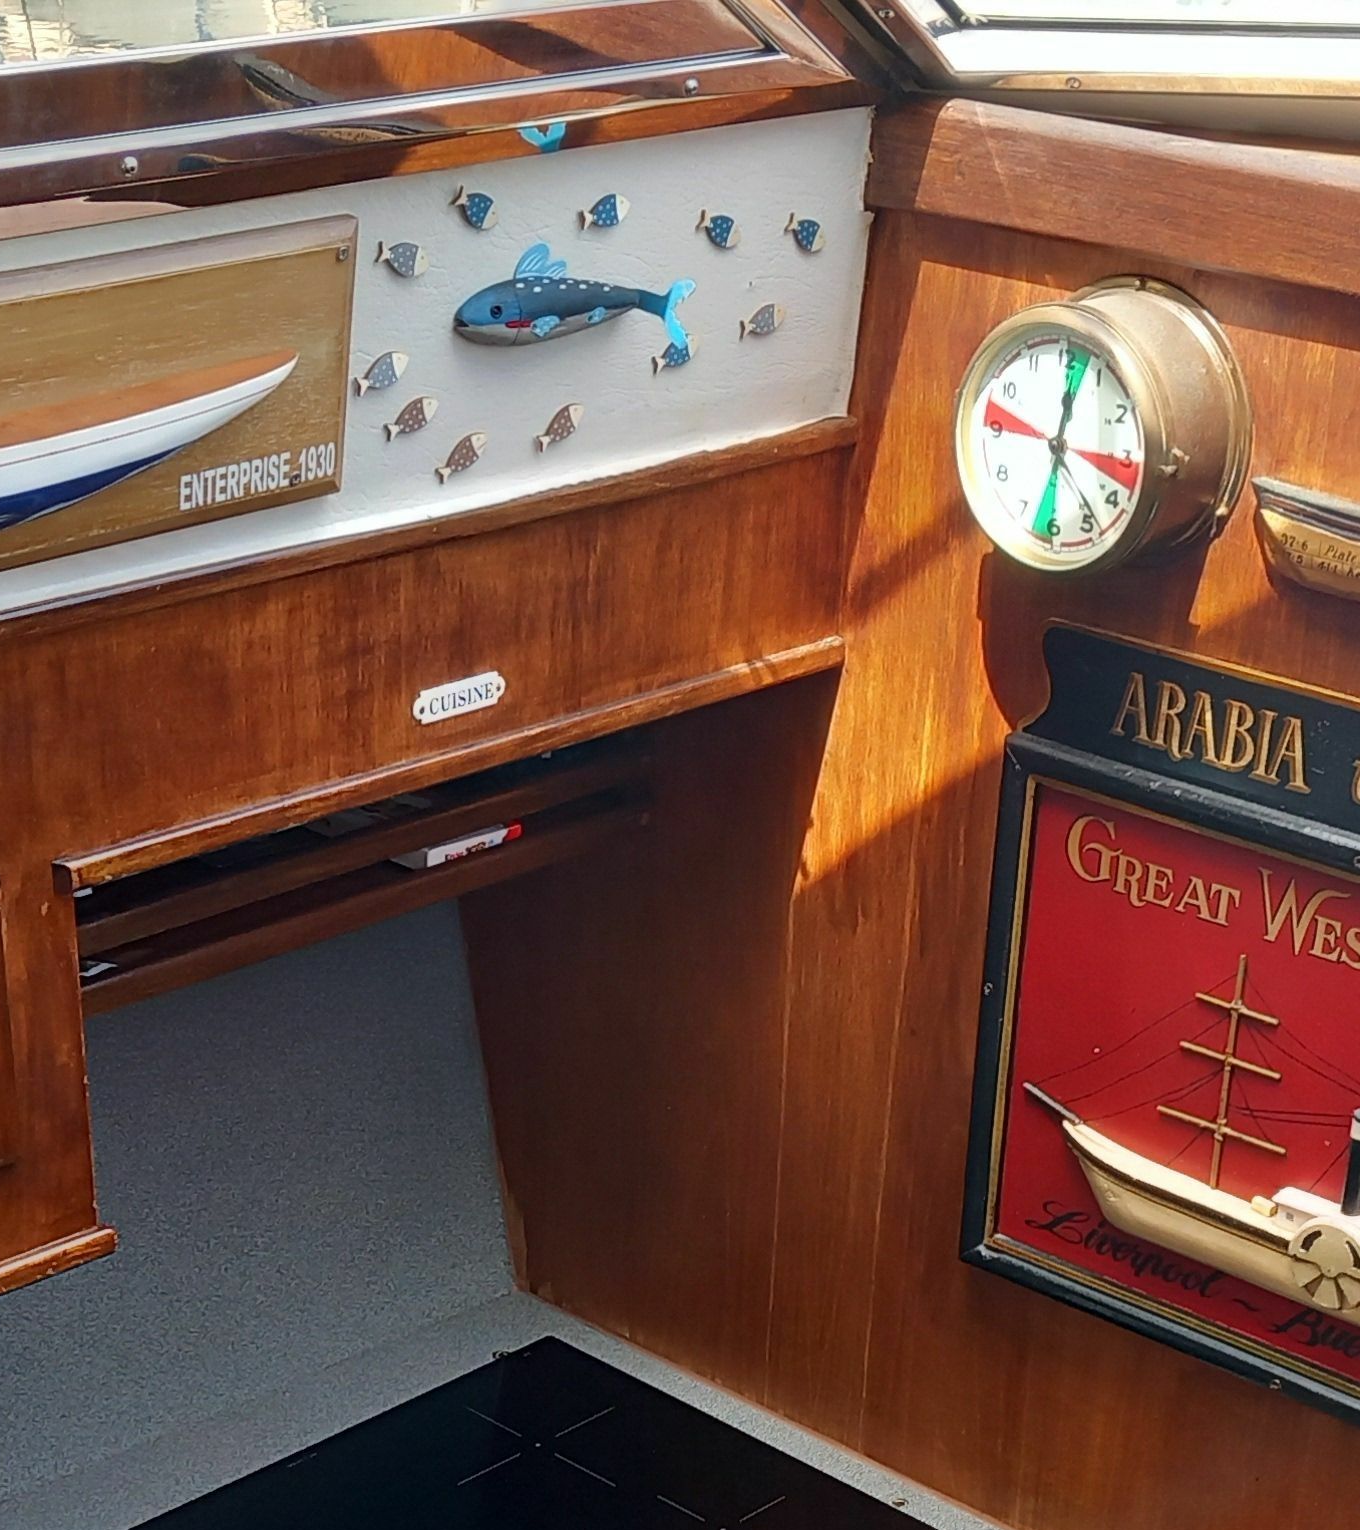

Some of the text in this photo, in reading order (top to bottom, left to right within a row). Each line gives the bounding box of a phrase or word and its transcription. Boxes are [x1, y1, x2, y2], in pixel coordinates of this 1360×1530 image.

[1029, 353, 1039, 373] 11
[1057, 347, 1076, 371] 12
[1096, 368, 1102, 387] 1
[1003, 382, 1016, 399] 10
[1114, 403, 1128, 424] 2
[990, 420, 1003, 438] 9
[1118, 449, 1133, 469] 3
[996, 464, 1009, 482] 8
[1019, 499, 1028, 517] 7
[1104, 489, 1119, 509] 4
[1046, 518, 1061, 536] 6
[1079, 512, 1094, 533] 5
[429, 681, 495, 716] CUISINE
[1110, 671, 1312, 795] ARABIA
[1065, 814, 1242, 927] GREAT
[1024, 1200, 1227, 1298] Liverpool
